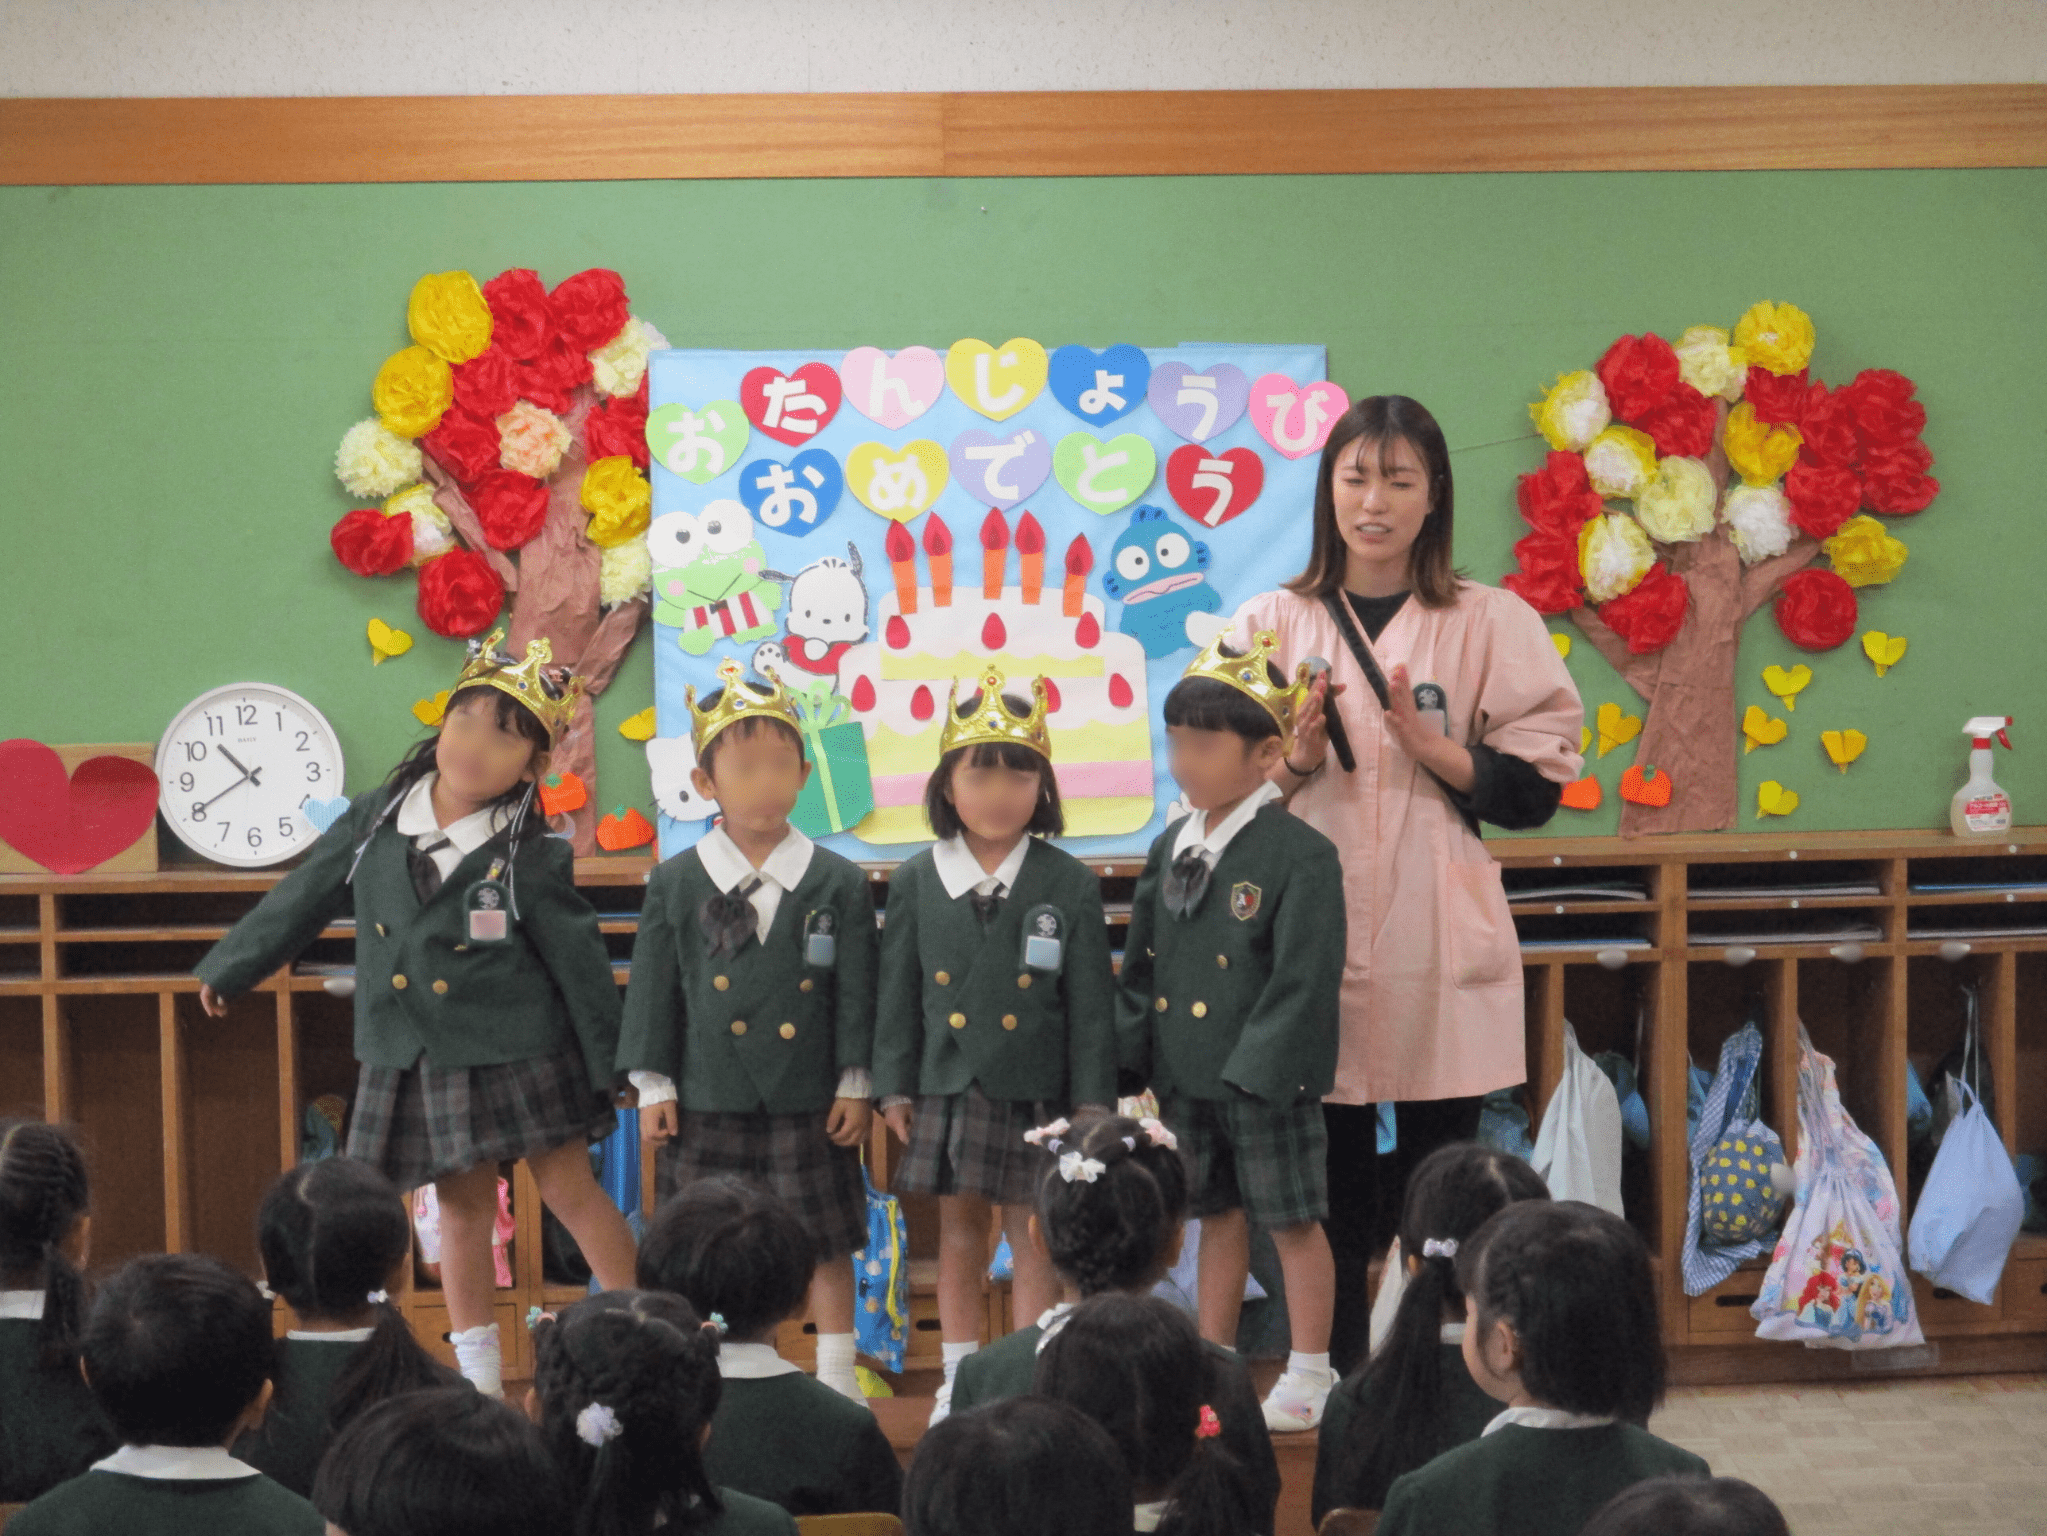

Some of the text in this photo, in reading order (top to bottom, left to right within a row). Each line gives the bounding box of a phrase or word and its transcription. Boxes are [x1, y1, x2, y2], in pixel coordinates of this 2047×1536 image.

[667, 351, 1328, 475] おたんじょうび
[755, 430, 1234, 524] おめでとう
[206, 716, 223, 736] 11
[235, 705, 258, 726] 12
[275, 711, 282, 732] 1
[184, 741, 207, 762] 10
[295, 731, 310, 752] 2
[179, 772, 195, 792] 9
[306, 762, 321, 782] 3
[191, 802, 207, 822] 8
[217, 821, 231, 842] 7
[247, 827, 262, 847] 6
[278, 817, 294, 837] 5
